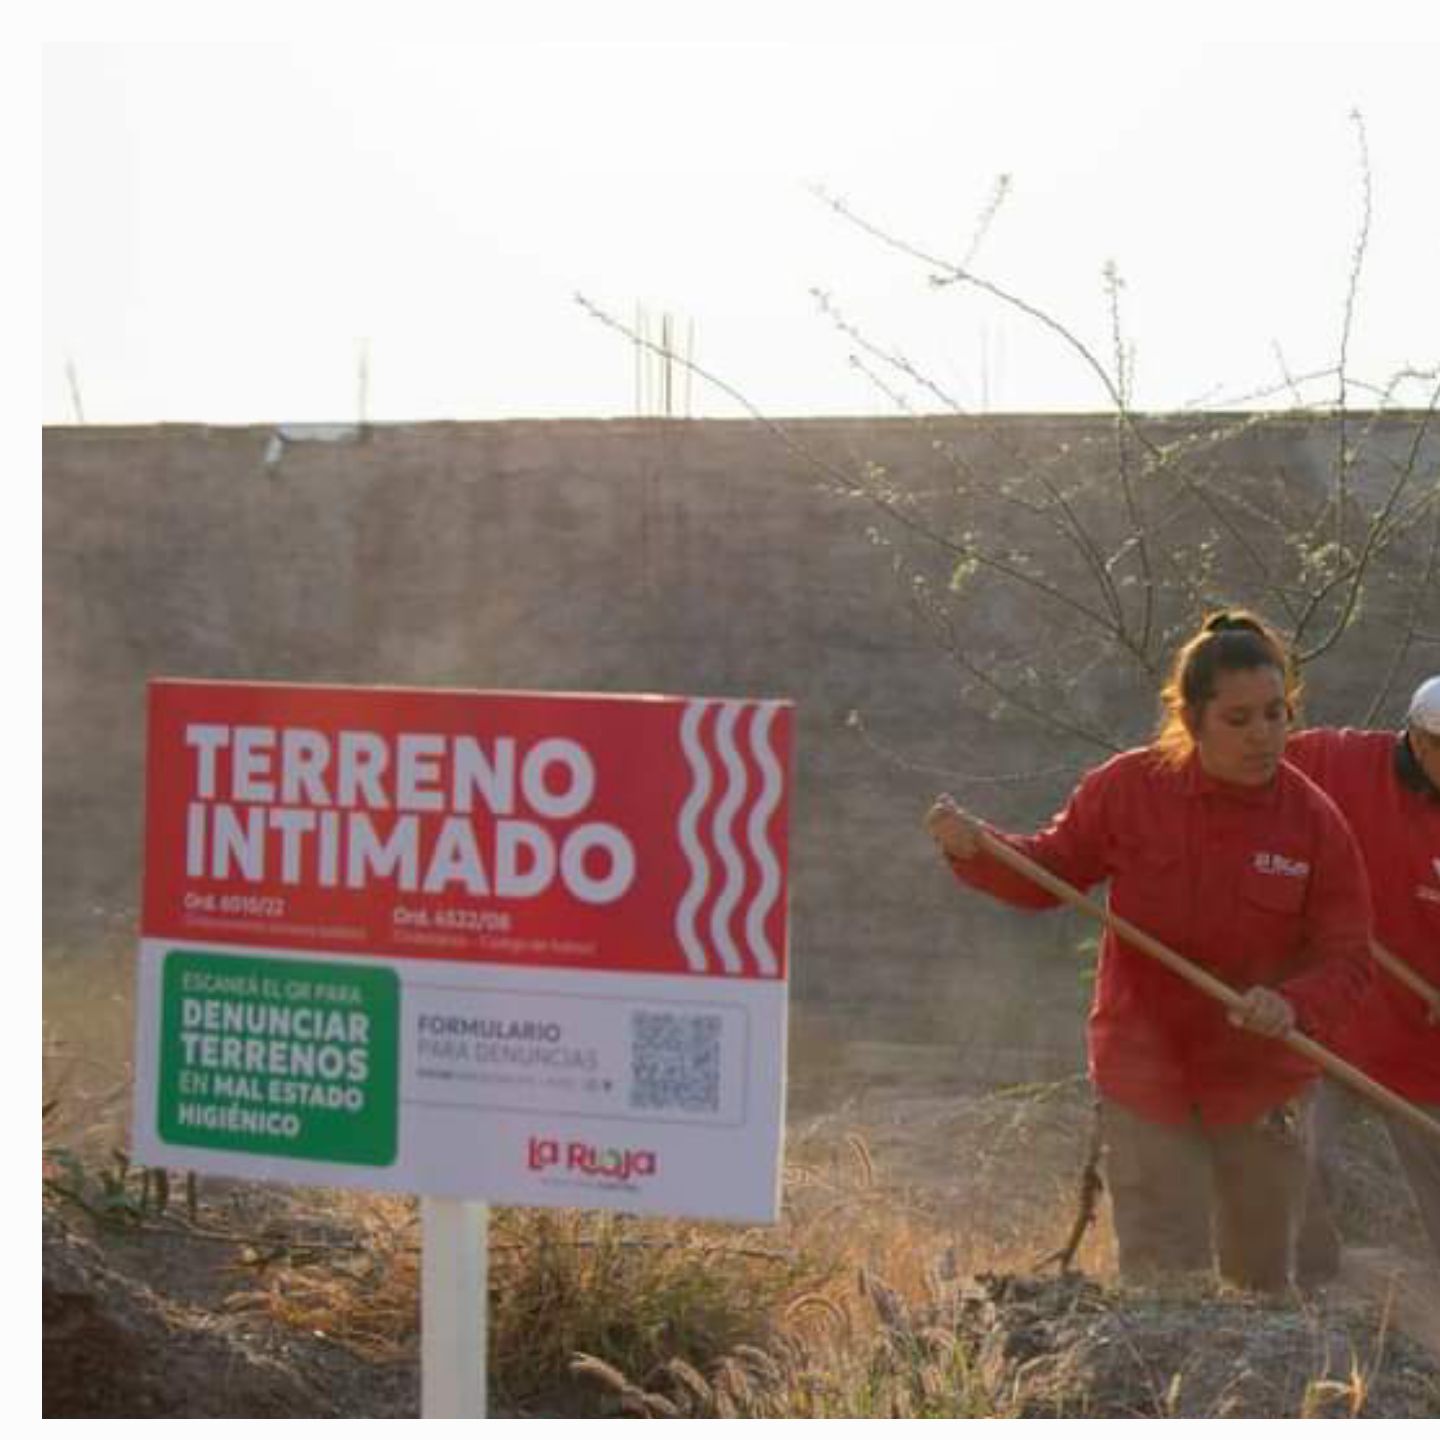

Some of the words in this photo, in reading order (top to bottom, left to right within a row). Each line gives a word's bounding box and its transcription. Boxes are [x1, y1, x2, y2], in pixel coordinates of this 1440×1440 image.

[186, 723, 596, 819] TERRENO
[185, 801, 637, 905] INTIMADO
[262, 977, 283, 999] EL
[313, 983, 362, 1003] PARA
[182, 998, 370, 1044] DENUNCIAR
[417, 1014, 562, 1044] FORMULARIO
[180, 1031, 369, 1083] TERRENOS
[417, 1037, 470, 1062] PARA
[476, 1041, 598, 1071] DENUNCIAS
[178, 1069, 208, 1096] EN
[213, 1073, 264, 1101] MAL
[268, 1080, 365, 1112] ESTADO
[178, 1101, 301, 1137] HIGIÉNICO
